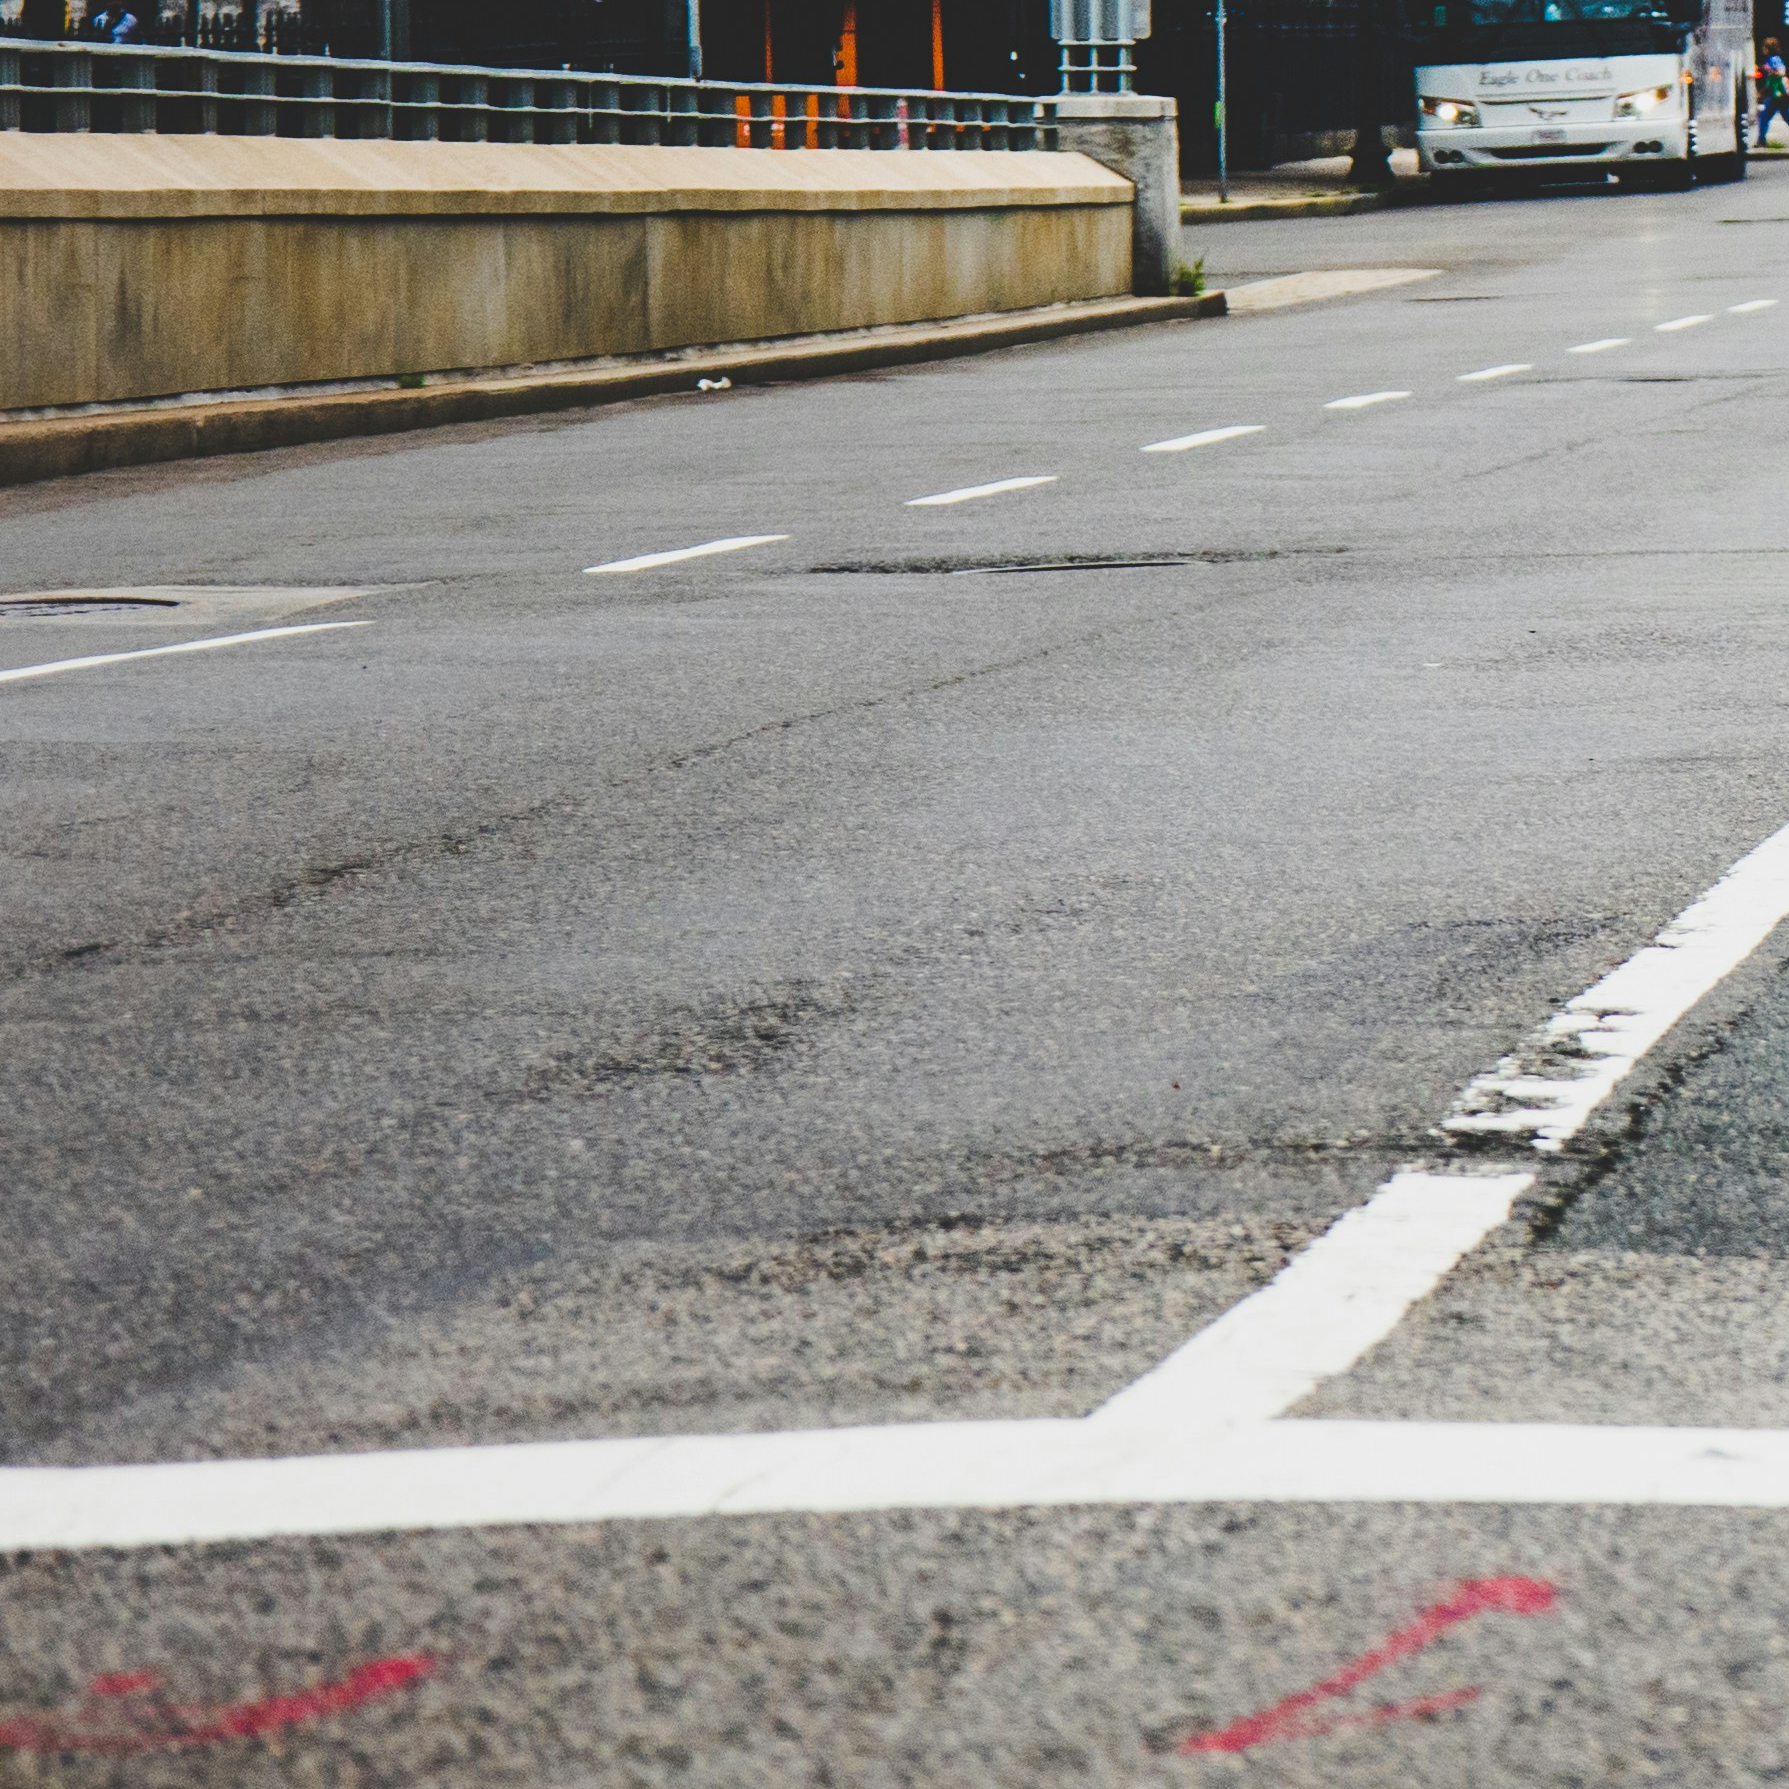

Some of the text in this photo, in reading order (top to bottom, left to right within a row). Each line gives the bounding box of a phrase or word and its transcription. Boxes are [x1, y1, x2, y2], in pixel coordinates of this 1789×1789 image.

[1479, 66, 1612, 87] Eagle One Coach
